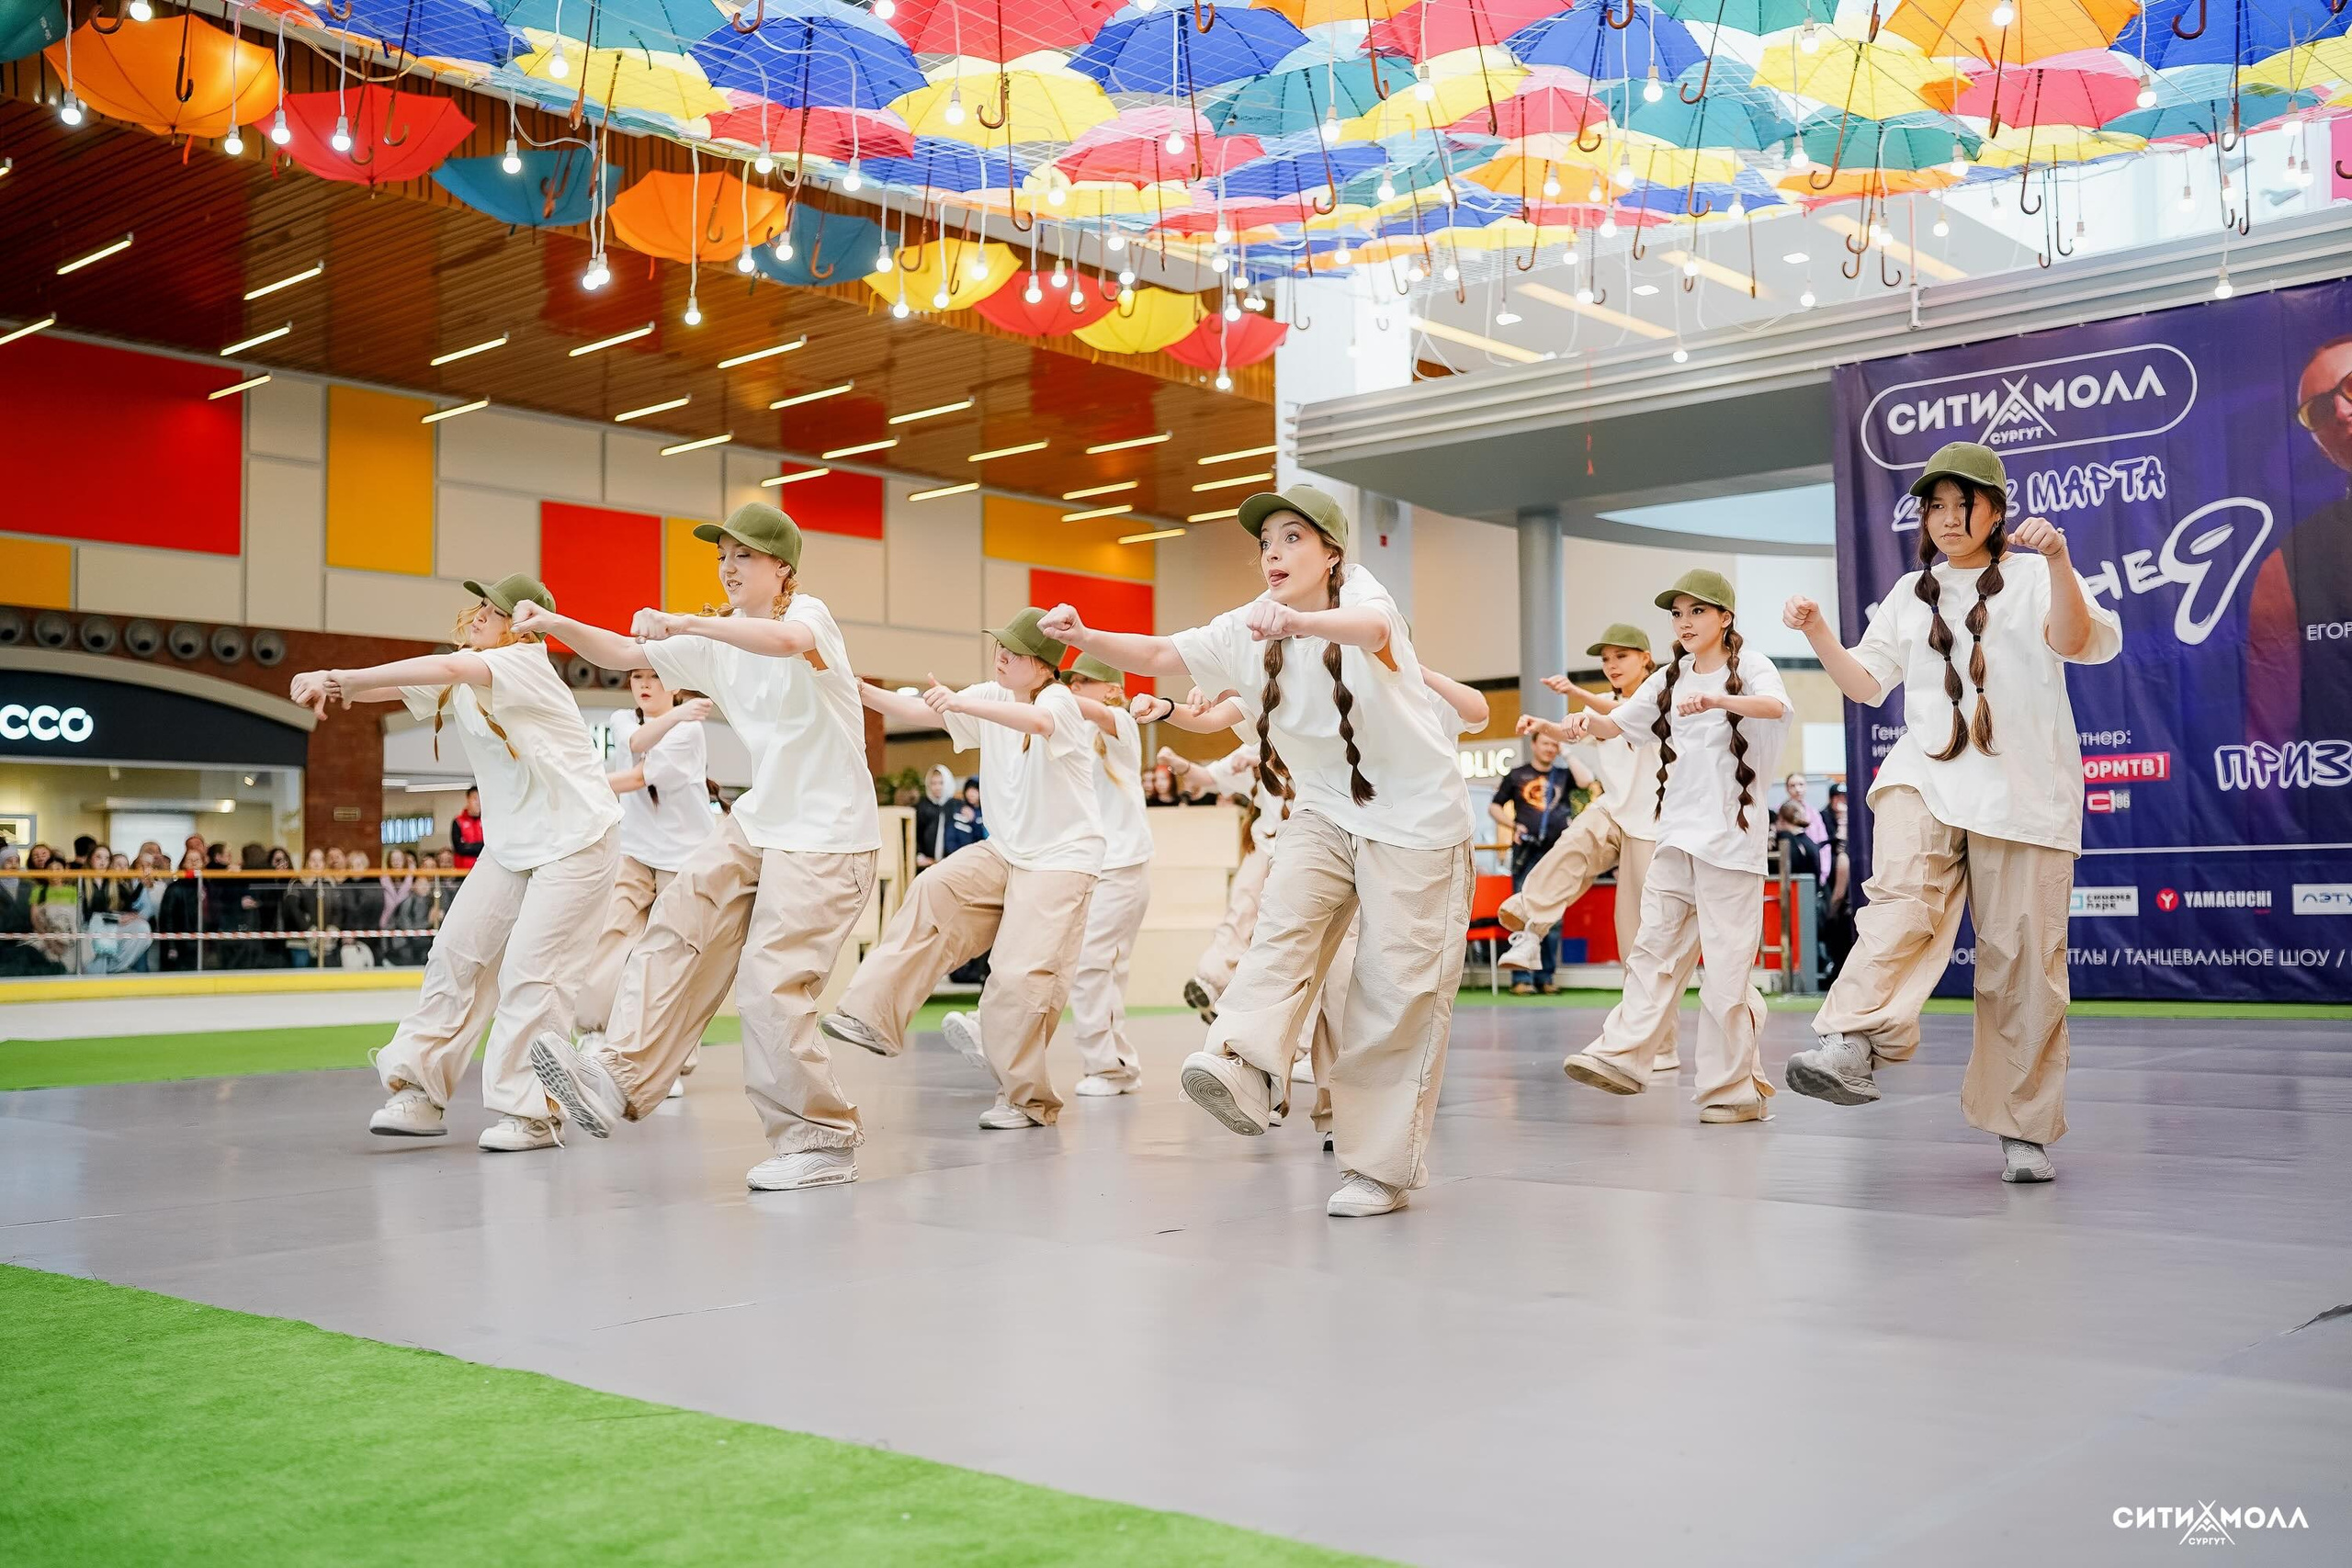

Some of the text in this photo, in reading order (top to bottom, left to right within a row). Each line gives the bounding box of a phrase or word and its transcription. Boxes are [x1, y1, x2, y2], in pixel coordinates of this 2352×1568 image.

[1886, 365, 2166, 435] СИТИ МОЛЛ
[1989, 425, 2043, 445] СУРГУТ
[2027, 456, 2165, 514] МАРТА
[2306, 621, 2352, 641] ЕГОР
[2183, 890, 2272, 908] YAMAGUCHI
[2124, 948, 2274, 967] ТАНЦЕВАЛЬНОЕ
[2278, 948, 2330, 966] ШОУ
